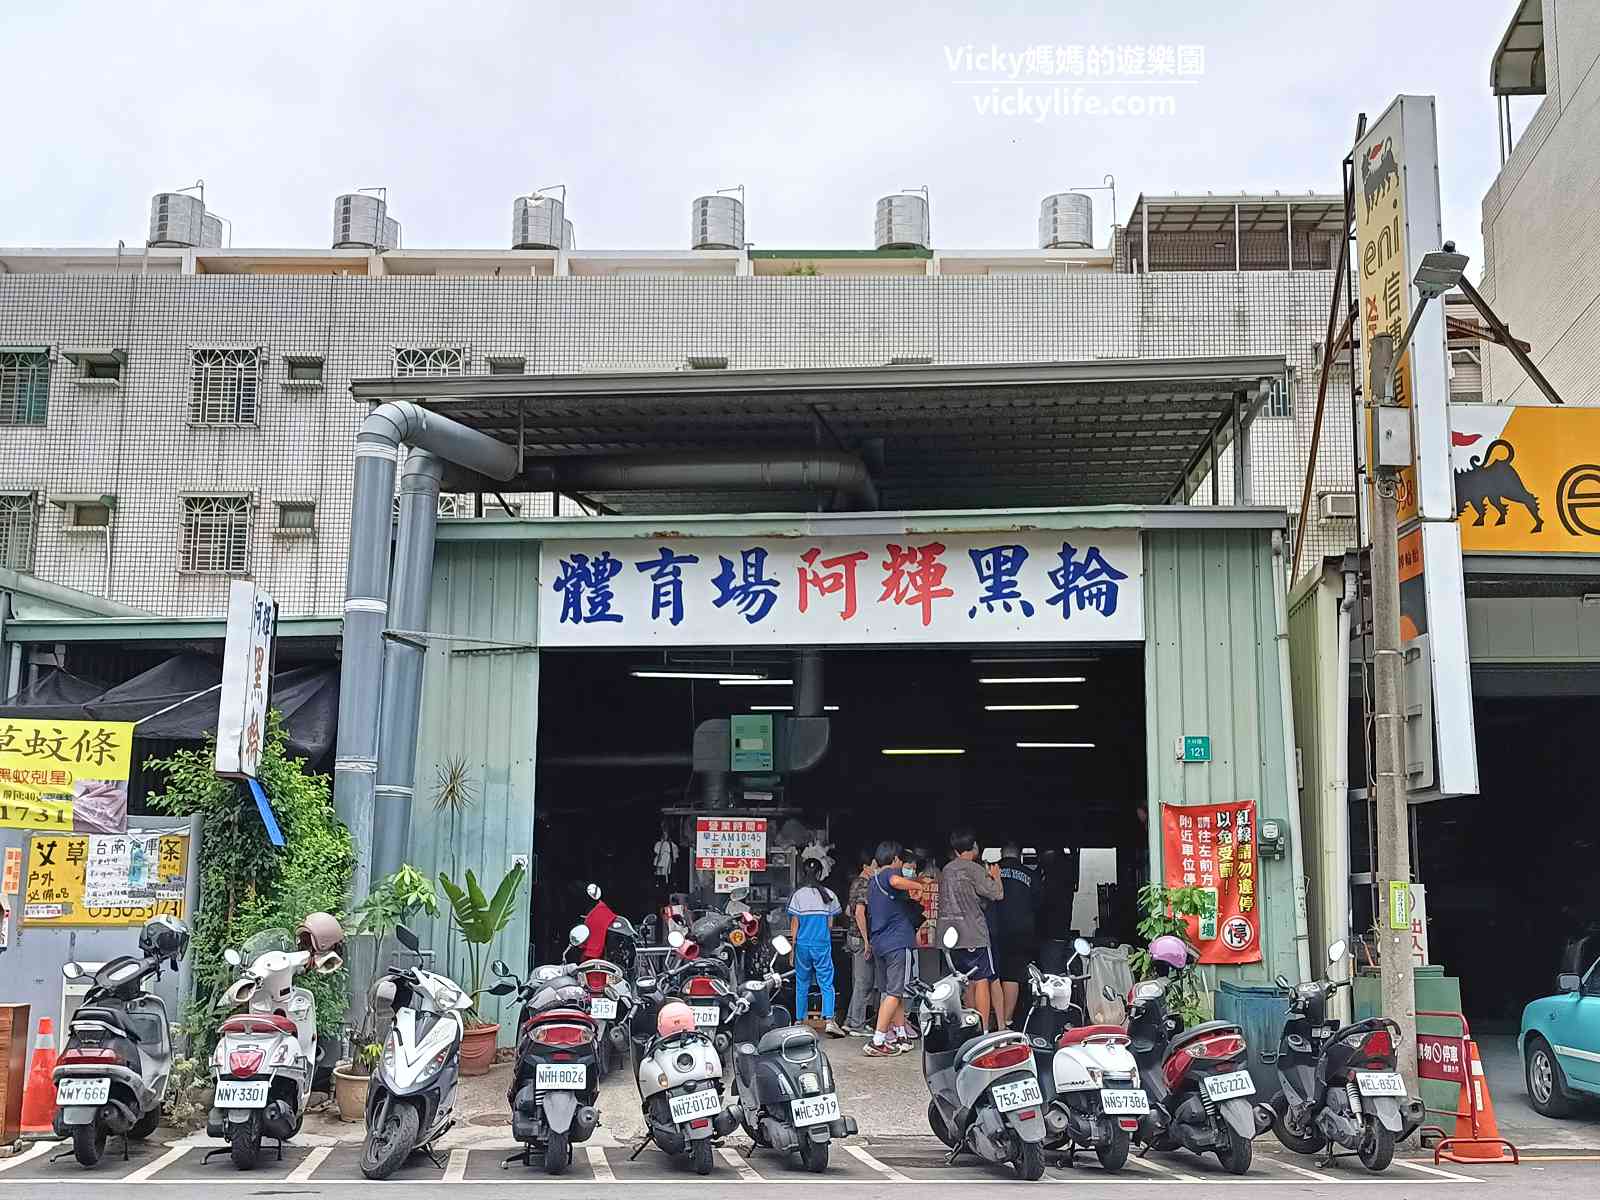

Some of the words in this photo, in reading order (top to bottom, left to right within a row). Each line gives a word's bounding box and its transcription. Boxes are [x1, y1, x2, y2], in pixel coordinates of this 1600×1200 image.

[1364, 199, 1400, 280] eni
[553, 542, 1128, 626] 體育場阿輝黑輪
[1191, 747, 1204, 757] 121
[36, 840, 88, 867] 艾草
[1236, 809, 1254, 913] 紅線請勿違停
[1229, 922, 1247, 944] 停
[1442, 1045, 1459, 1064] 停車
